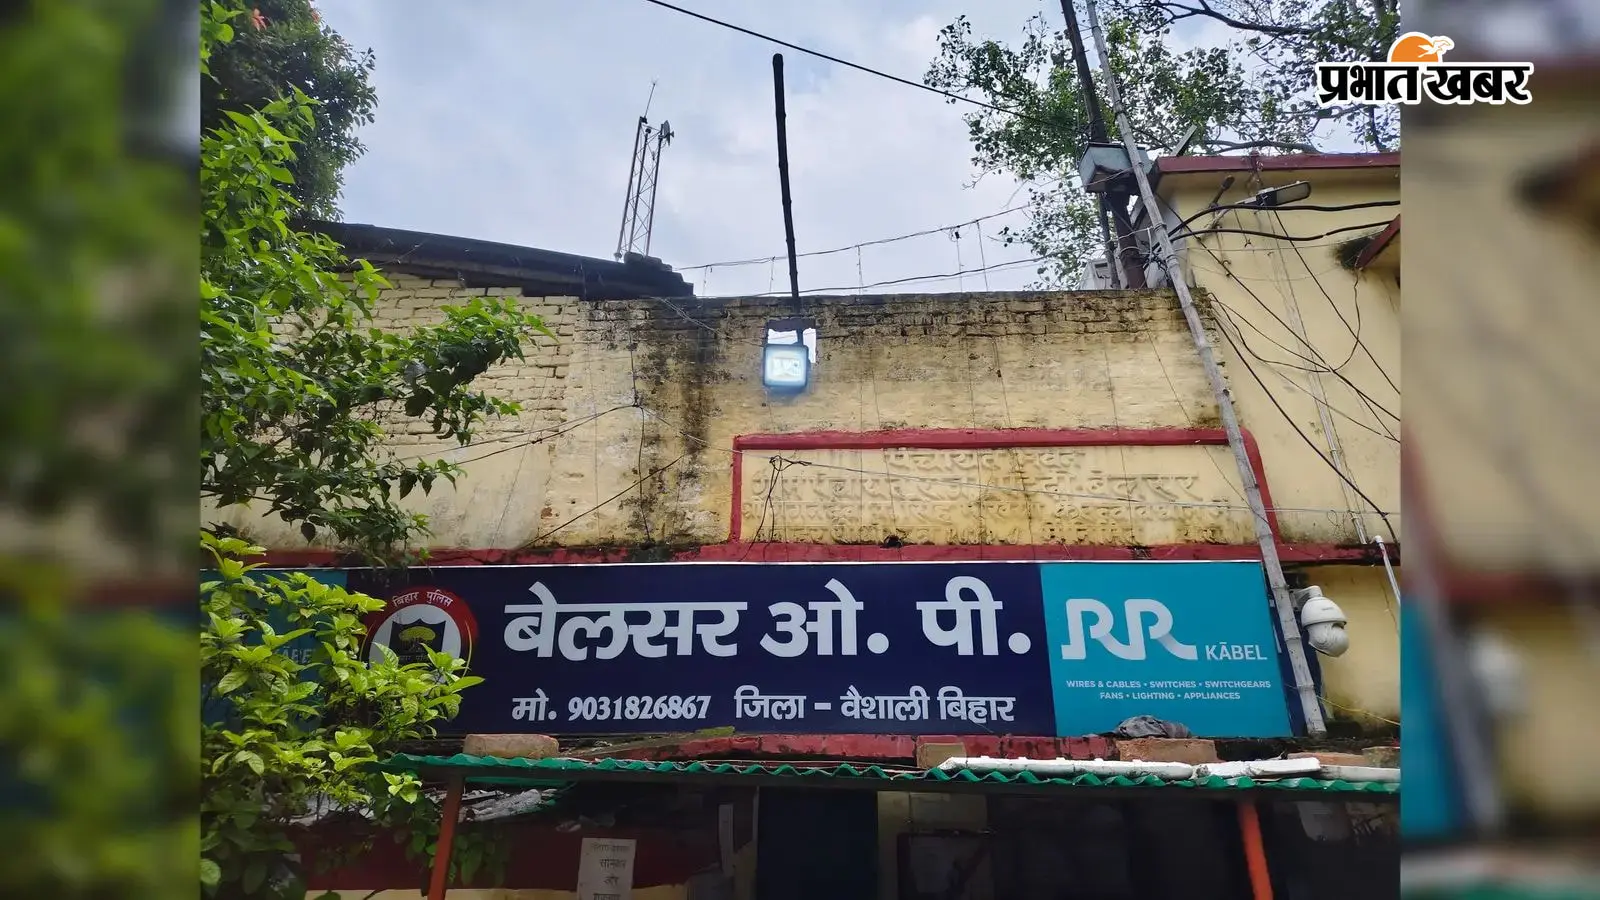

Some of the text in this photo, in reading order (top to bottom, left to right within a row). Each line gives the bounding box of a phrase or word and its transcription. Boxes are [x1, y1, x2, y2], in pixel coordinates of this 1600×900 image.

[503, 576, 1032, 661] बेलसर ओ. पी.
[1061, 598, 1268, 660] RR KĀBEL
[1066, 680, 1271, 688] WIRES & CABLES SWITCHES SWITCHGEARS
[1100, 691, 1241, 700] FANS LIGHTING APPLIANCES
[511, 688, 557, 721] मो.
[568, 695, 711, 721] 9031826867
[734, 685, 807, 719] जिला
[840, 685, 930, 721] वैशाली
[937, 686, 1016, 724] बिहार
